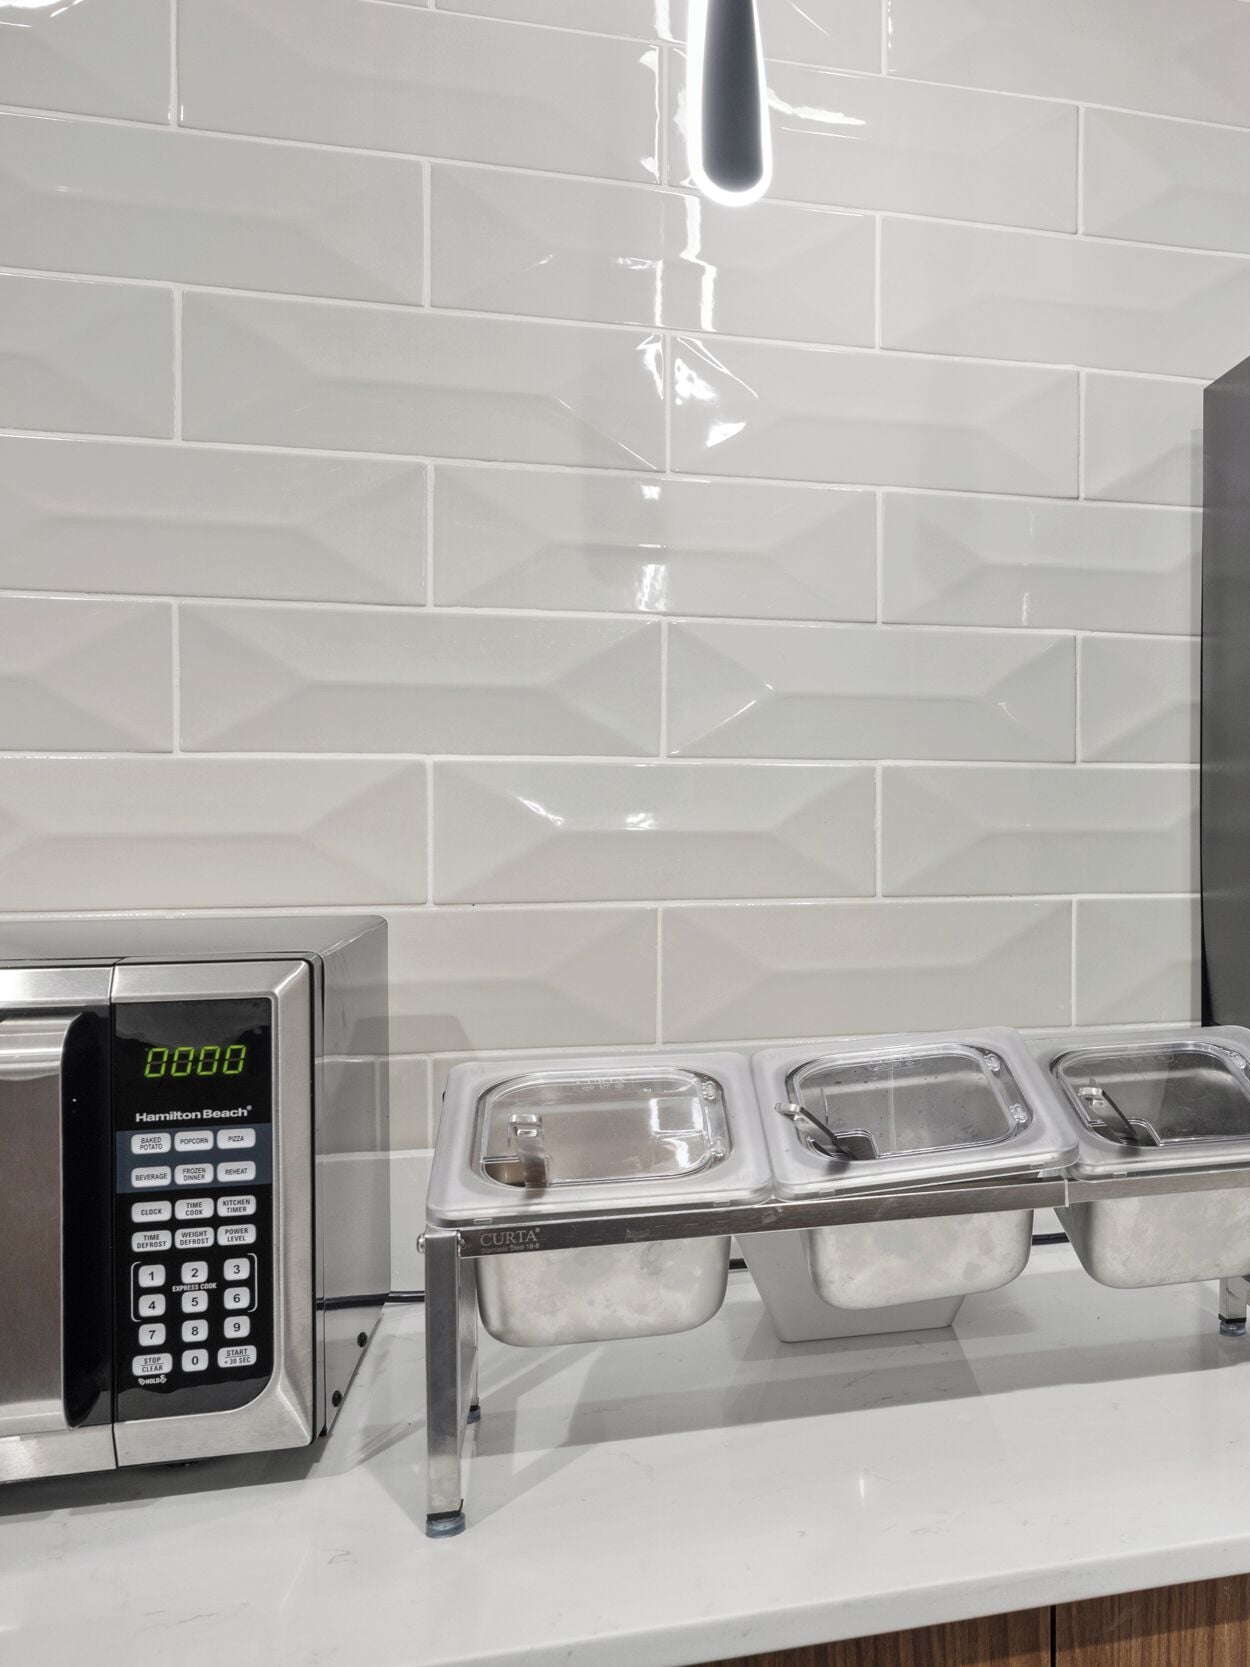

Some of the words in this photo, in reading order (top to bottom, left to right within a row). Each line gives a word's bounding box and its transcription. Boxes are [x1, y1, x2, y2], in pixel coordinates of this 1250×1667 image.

[136, 1111, 200, 1123] Hamilton
[141, 1136, 161, 1144] BAKED
[228, 1135, 244, 1143] PIZZA
[225, 1168, 248, 1176] REHEAT
[135, 1173, 168, 1181] BEVERAGE
[184, 1174, 205, 1182] DINNER
[223, 1199, 251, 1207] KITCHEN
[226, 1206, 247, 1214] TIMER
[182, 1230, 207, 1239] WEIGHT
[225, 1227, 249, 1235] POWER
[180, 1238, 209, 1246] DEFROST
[227, 1235, 246, 1243] LEVEL
[137, 1241, 167, 1249] DEFROST
[191, 1268, 199, 1278] 2
[233, 1264, 241, 1275] 3
[148, 1271, 155, 1281] 1
[172, 1284, 199, 1292] EXPRESS
[200, 1282, 217, 1290] COOK
[191, 1297, 199, 1307] 5
[233, 1293, 241, 1303] 6
[148, 1301, 156, 1311] 4
[191, 1326, 199, 1336] 8
[233, 1322, 241, 1332] 9
[148, 1329, 156, 1340] 7
[226, 1348, 248, 1356] START
[191, 1355, 199, 1366] 0
[239, 1356, 251, 1364] SEC
